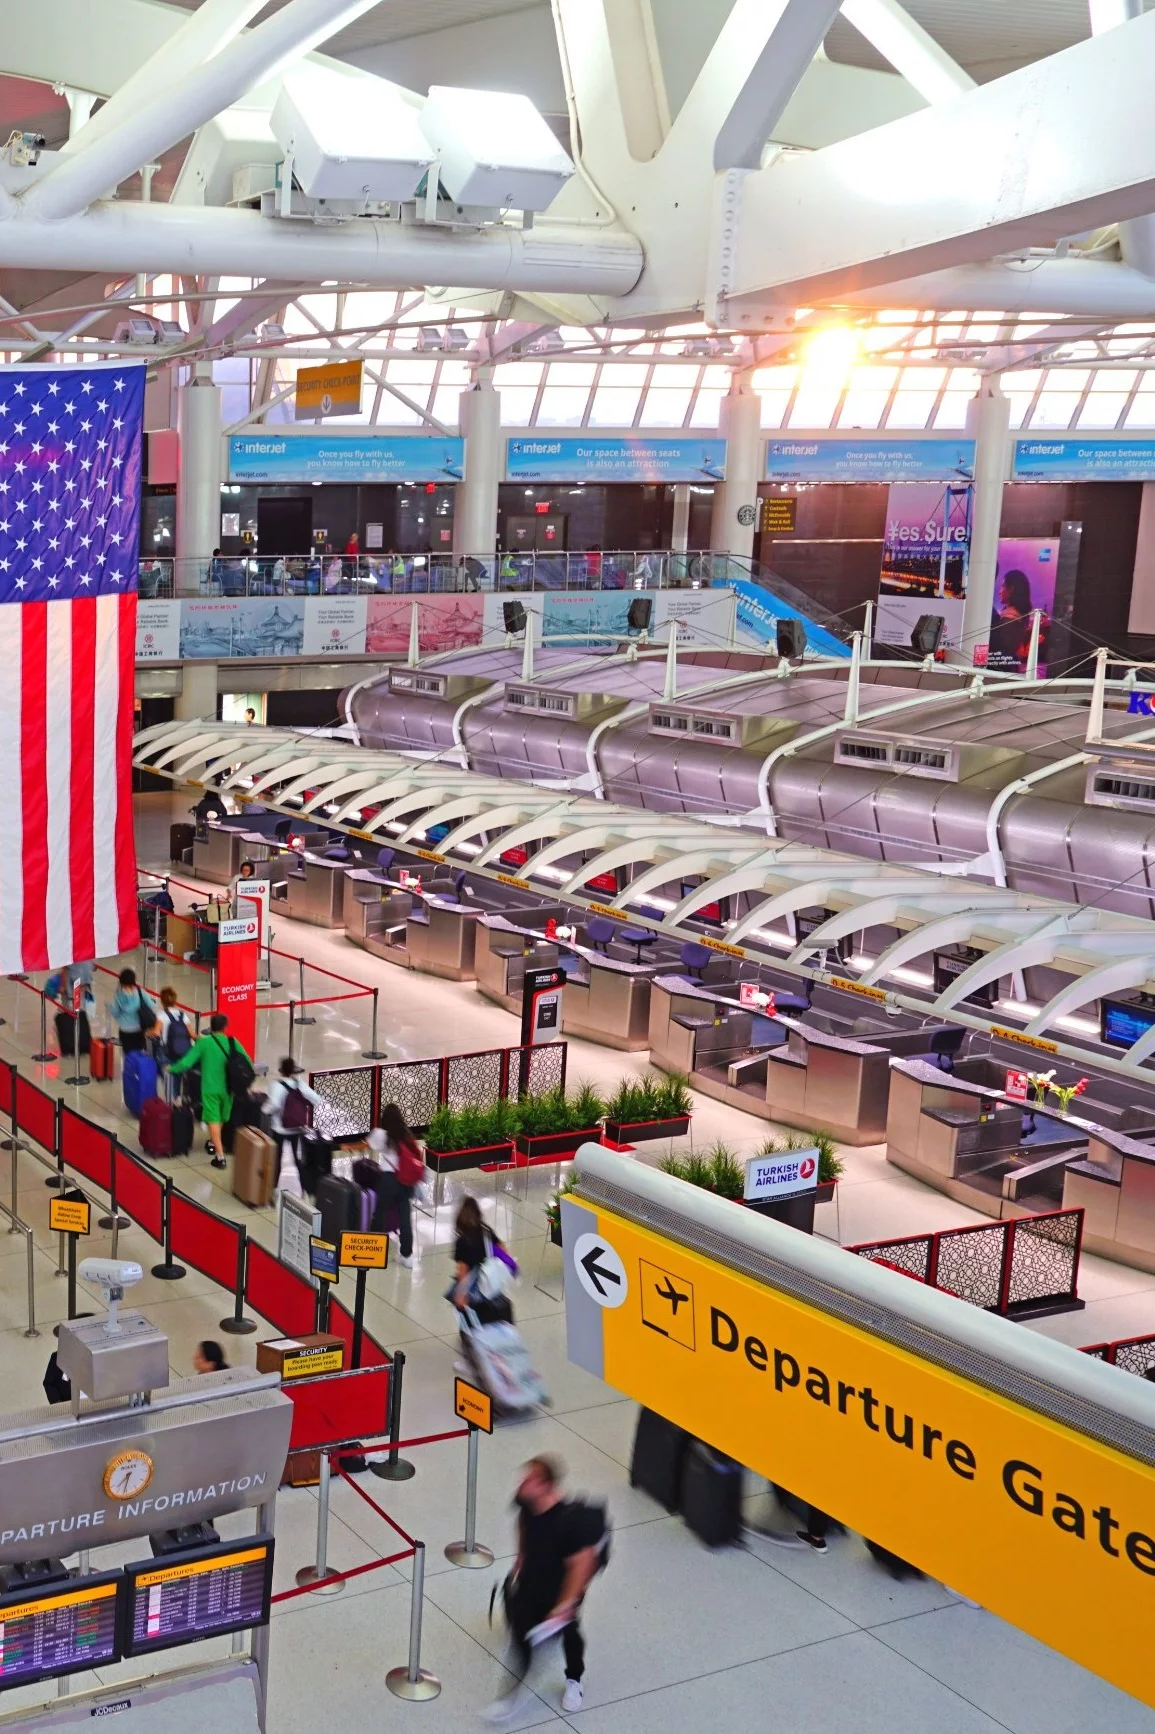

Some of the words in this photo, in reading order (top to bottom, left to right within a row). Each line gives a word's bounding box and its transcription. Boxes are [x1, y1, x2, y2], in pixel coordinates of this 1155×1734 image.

[245, 441, 286, 454] interjet
[523, 443, 562, 455] interjet
[782, 444, 819, 456] interjet
[1029, 444, 1065, 455] interjet
[318, 450, 339, 458] Once
[340, 451, 354, 460] you
[354, 450, 365, 460] fly
[365, 450, 381, 458] with
[577, 448, 592, 457] Our
[594, 450, 619, 460] space
[621, 448, 657, 457] between
[659, 449, 680, 457] seats
[846, 451, 864, 459] Once
[864, 452, 877, 462] you
[878, 452, 887, 461] fly
[887, 452, 901, 460] with
[1078, 449, 1092, 457] Our
[1095, 450, 1117, 459] space
[1118, 449, 1152, 457] between
[307, 459, 321, 468] you
[321, 459, 343, 467] know
[344, 459, 360, 467] how
[370, 459, 381, 468] fly
[381, 459, 405, 467] better
[586, 459, 595, 468] is
[595, 459, 614, 468] also
[615, 460, 626, 468] an
[627, 459, 669, 468] attraction
[836, 461, 848, 470] you
[849, 460, 868, 468] know
[868, 460, 884, 468] how
[892, 460, 902, 469] fly
[235, 471, 268, 479] interjet.com
[511, 471, 541, 479] interjet.com
[221, 983, 255, 994] ECONOMY
[227, 993, 248, 1003] CLASS
[757, 1163, 799, 1178] TURKISH
[755, 1172, 798, 1187] AIRLINES
[344, 1244, 383, 1252] CHECK-POINT
[299, 1346, 328, 1357] SECURITY
[292, 1357, 308, 1365] Please
[287, 1363, 311, 1372] boarding
[710, 1305, 977, 1481] Departure
[462, 1397, 484, 1414] ECONOMY
[117, 1471, 268, 1520] INFORMATION
[148, 1566, 195, 1583] Departures
